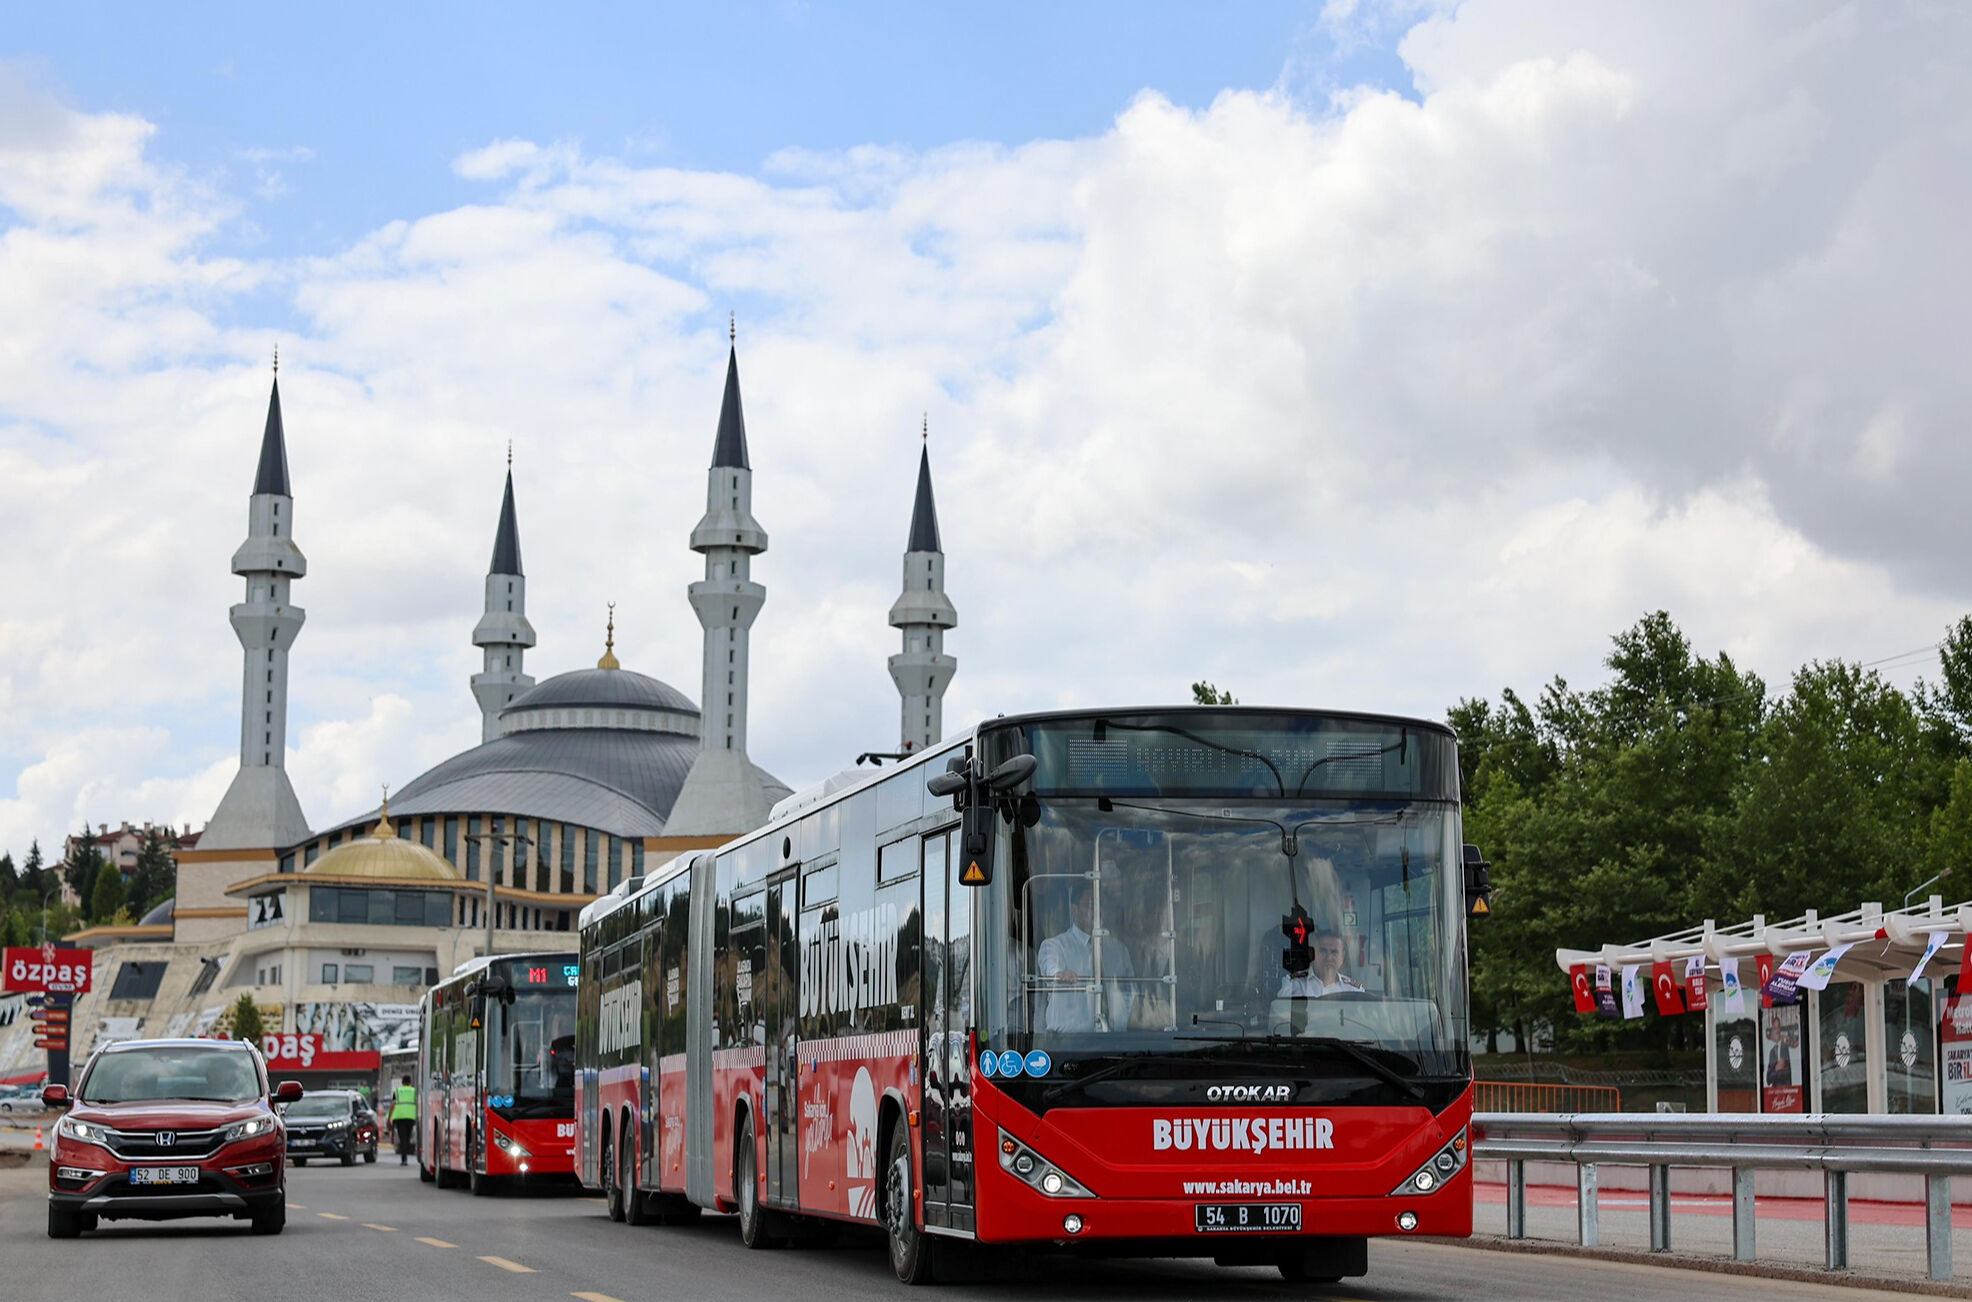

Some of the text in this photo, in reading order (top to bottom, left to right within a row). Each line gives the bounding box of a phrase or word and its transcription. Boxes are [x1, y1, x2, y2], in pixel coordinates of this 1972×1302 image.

[12, 960, 87, 988] özpaş
[1207, 1085, 1290, 1101] OTOKAR
[1153, 1117, 1334, 1155] BÜYÜKŞEHİR
[137, 1168, 196, 1180] 52 DE 900
[1183, 1179, 1312, 1197] www.sakarya.bel.tr
[1206, 1206, 1299, 1225] 54 B 1070
